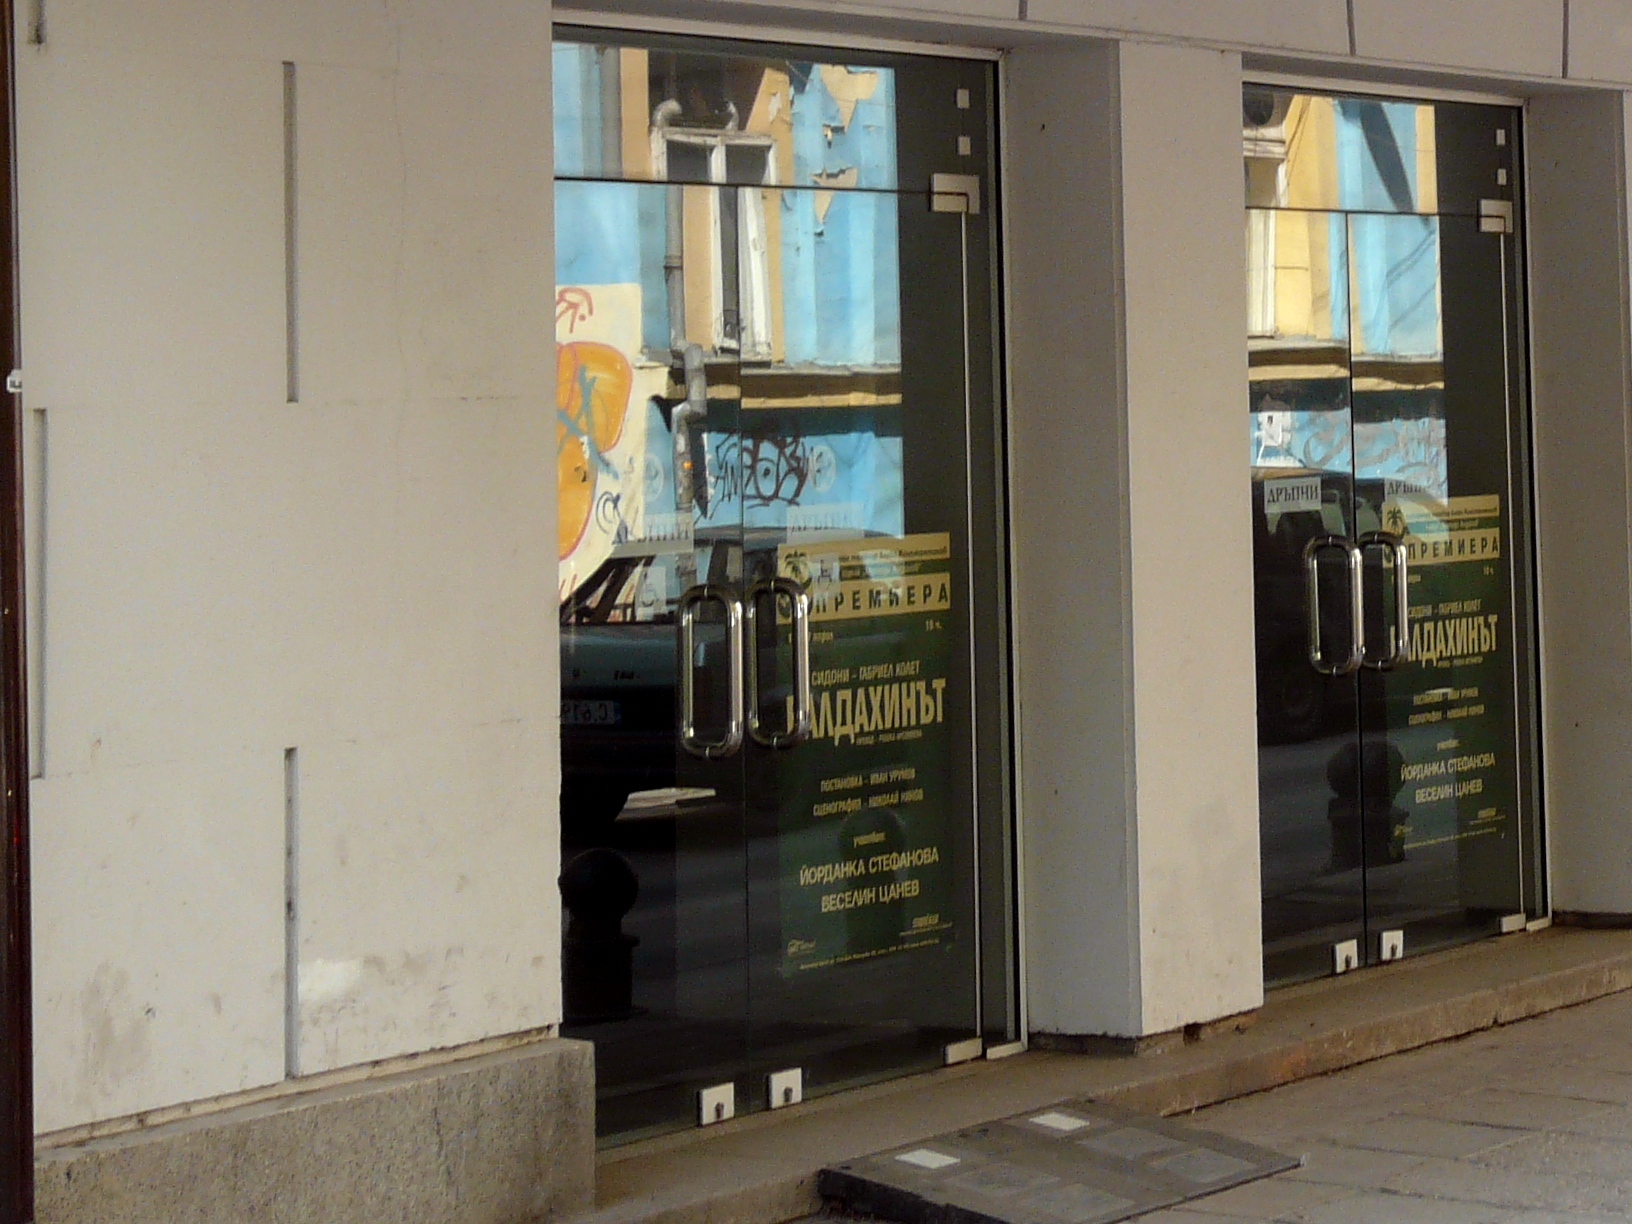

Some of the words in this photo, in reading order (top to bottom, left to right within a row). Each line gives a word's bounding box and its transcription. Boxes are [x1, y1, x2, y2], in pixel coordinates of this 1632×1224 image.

[1408, 536, 1499, 560] ПРЕМИЕРА
[816, 583, 949, 614] ПРЕМИЕРА
[800, 859, 866, 886] ЙОРДАНКА
[868, 846, 940, 874] СТЕФАНОВА
[821, 887, 876, 913] ВЕСЕЛИН
[879, 880, 920, 904] ЦАНЕВ
